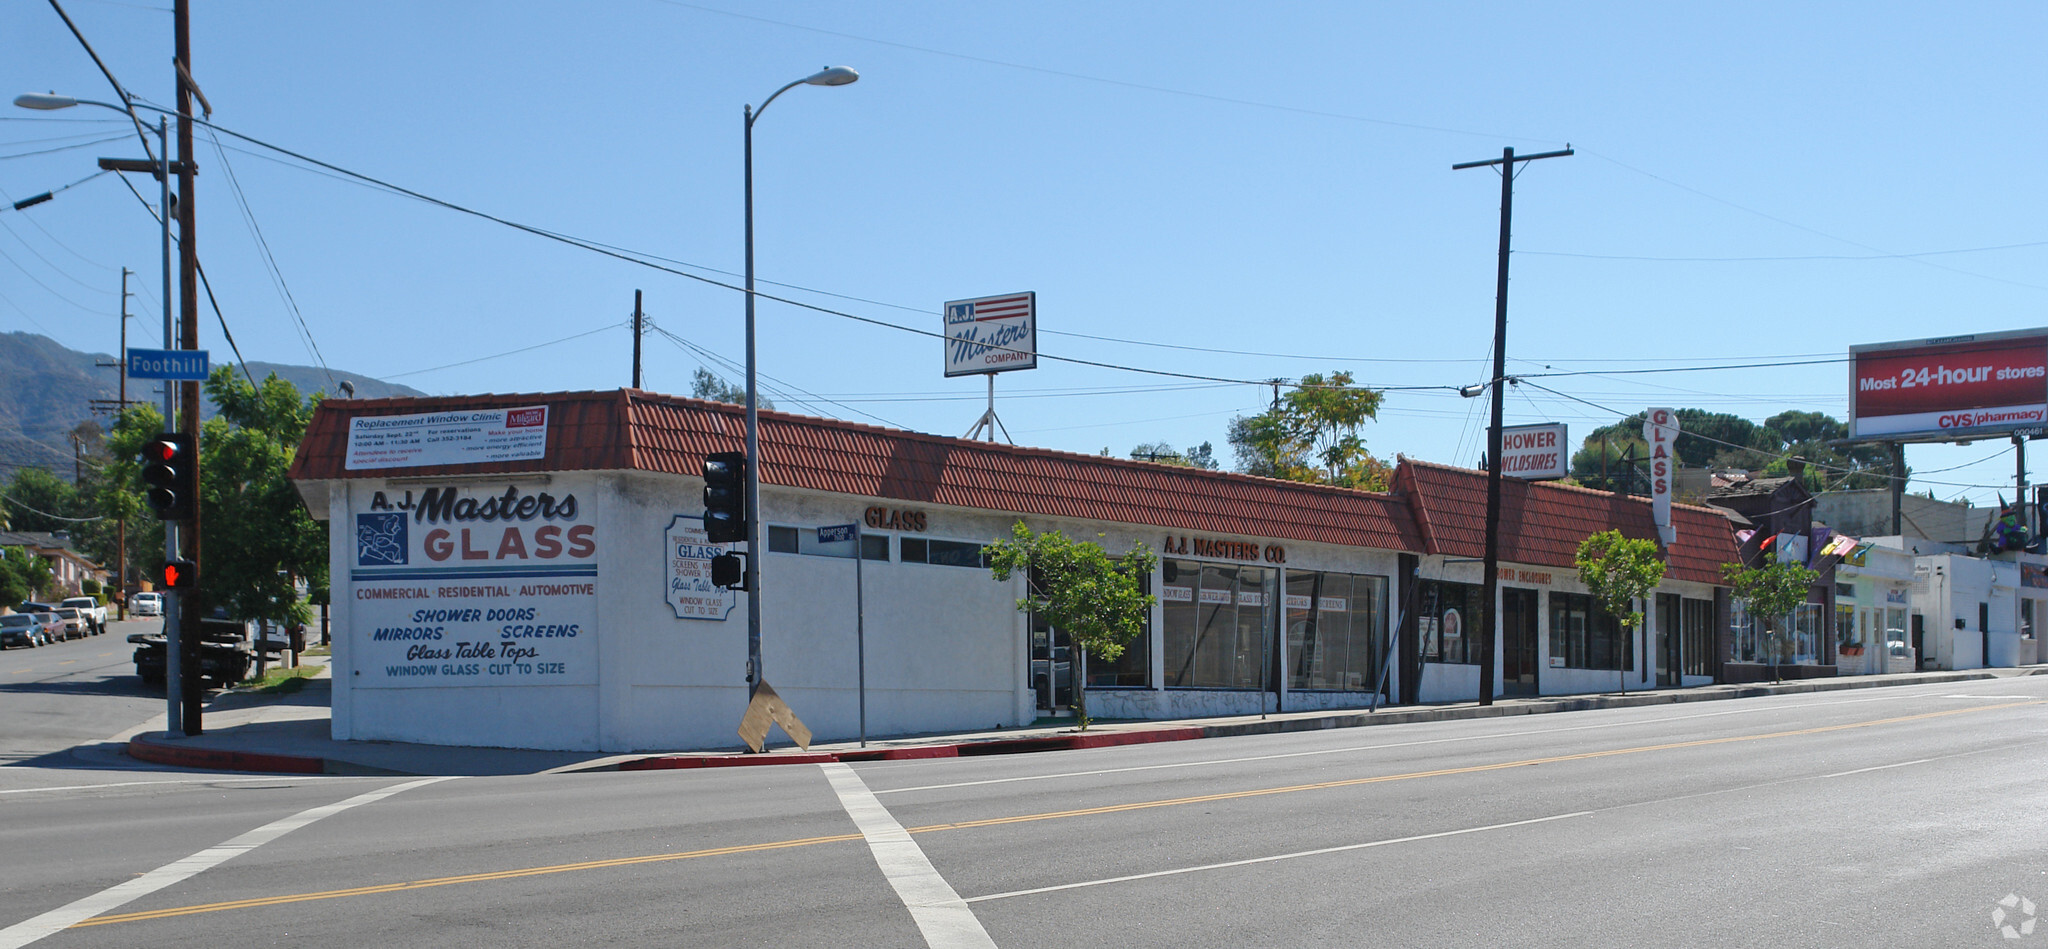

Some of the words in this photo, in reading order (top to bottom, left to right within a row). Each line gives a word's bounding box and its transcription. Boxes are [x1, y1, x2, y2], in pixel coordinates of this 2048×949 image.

[950, 320, 1029, 365] Masters
[132, 356, 203, 373] Foothill
[985, 352, 1028, 364] COMPANY
[1860, 376, 1897, 391] Most
[1901, 365, 1993, 388] 24-hour
[1996, 366, 2045, 380] stores
[355, 417, 424, 430] Replacement
[427, 415, 470, 424] Window
[471, 413, 501, 422] Clinic
[509, 411, 542, 426] Milgard
[1938, 409, 2044, 428] CVS/pharmacy
[1503, 432, 1556, 450] HOWER
[1653, 410, 1668, 494] GLASS
[1501, 453, 1557, 472] NCLOSURES
[415, 485, 578, 524] Masters
[865, 506, 928, 532] GLASS
[819, 526, 848, 537] Apperson
[424, 525, 596, 561] GLASS
[1193, 538, 1260, 561] MASTERS
[1265, 545, 1286, 563] CO.
[678, 545, 722, 559] GLASS
[672, 560, 698, 569] SCREENS
[675, 569, 701, 577] SHOWER
[672, 577, 690, 594] Glass
[693, 578, 711, 592] Table
[1518, 570, 1552, 585] ENCLOSURES
[357, 587, 430, 600] COMMERCIAL
[438, 586, 510, 598] RESIDENTIAL
[519, 584, 594, 596] AUTOMOTIVE
[1254, 595, 1269, 605] TOS
[679, 596, 704, 605] WINDOW
[706, 598, 722, 607] GLASS
[412, 608, 481, 623] SHOWER
[486, 607, 535, 621] DOORS
[684, 606, 695, 614] CUT
[698, 607, 705, 615] TO
[708, 607, 718, 615] SIZE
[373, 627, 444, 641] MIRRORS
[501, 624, 579, 639] SCREENS
[407, 645, 452, 661] Glass
[455, 642, 496, 659] Table
[500, 641, 539, 664] Tops
[386, 665, 437, 677] WINDOW
[442, 664, 480, 676] GLASS
[488, 663, 512, 675] CUT
[516, 663, 532, 675] TO
[537, 662, 565, 674] SIZE
